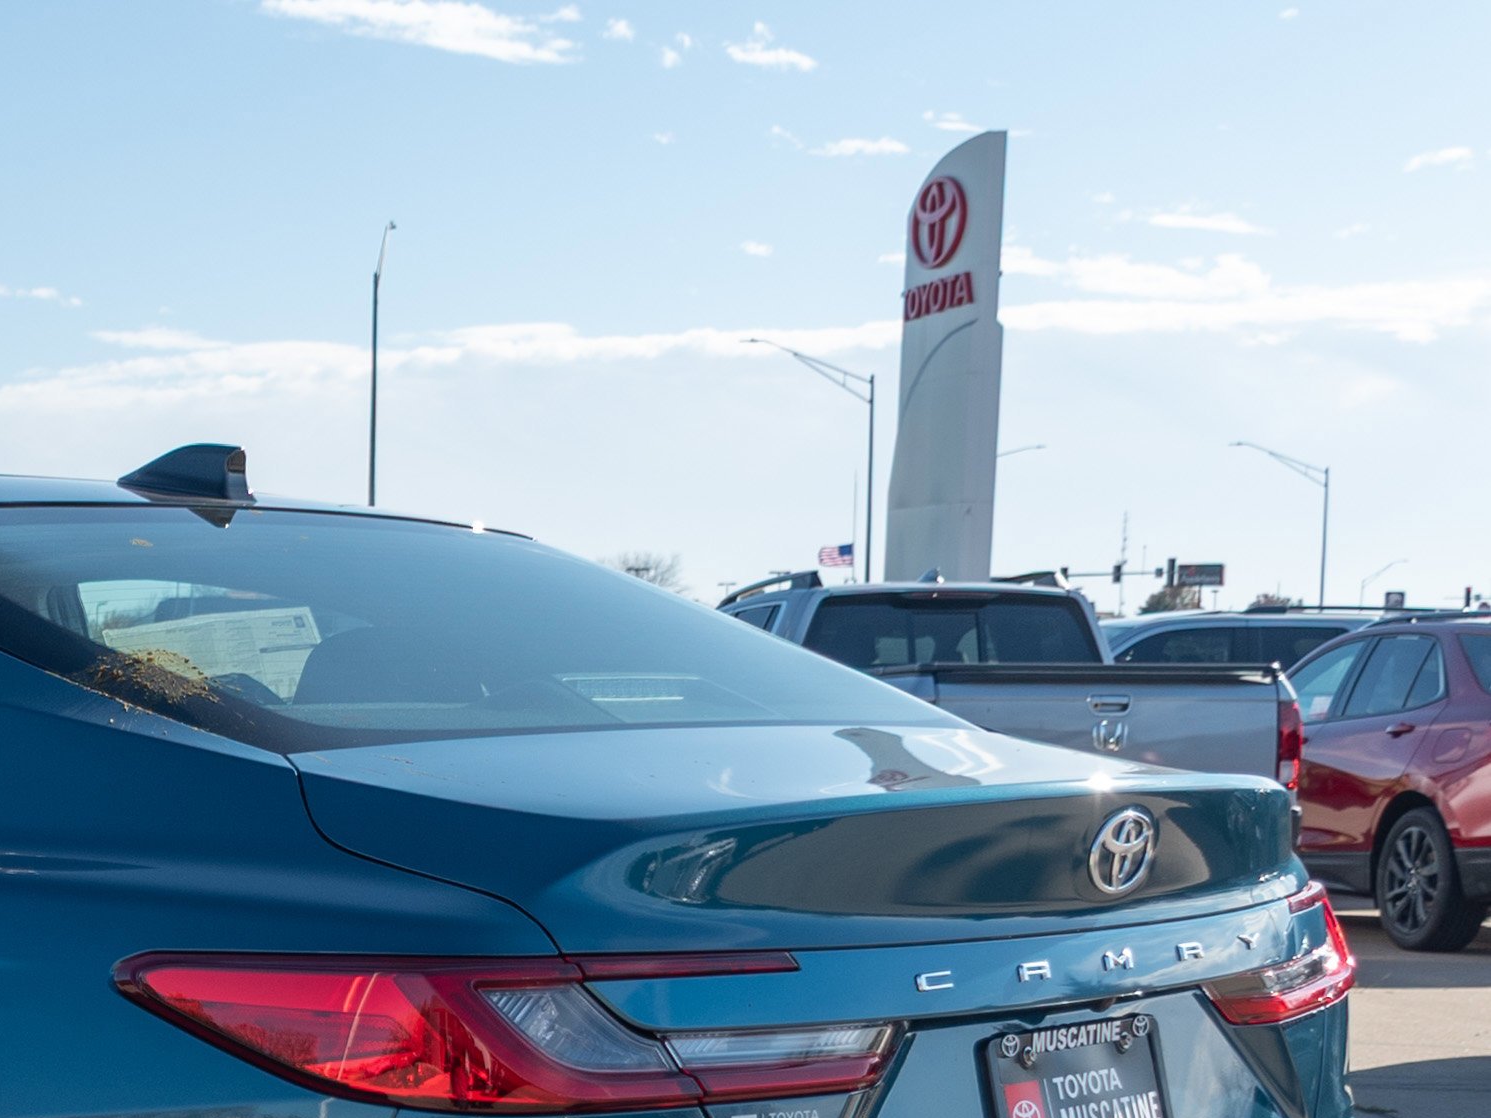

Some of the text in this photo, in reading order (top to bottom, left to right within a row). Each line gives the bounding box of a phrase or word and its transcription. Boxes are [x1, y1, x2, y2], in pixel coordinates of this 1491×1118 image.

[915, 931, 1261, 993] CAMRY
[1032, 1020, 1121, 1054] MUSCATINE
[1052, 1067, 1122, 1100] TOYOTA
